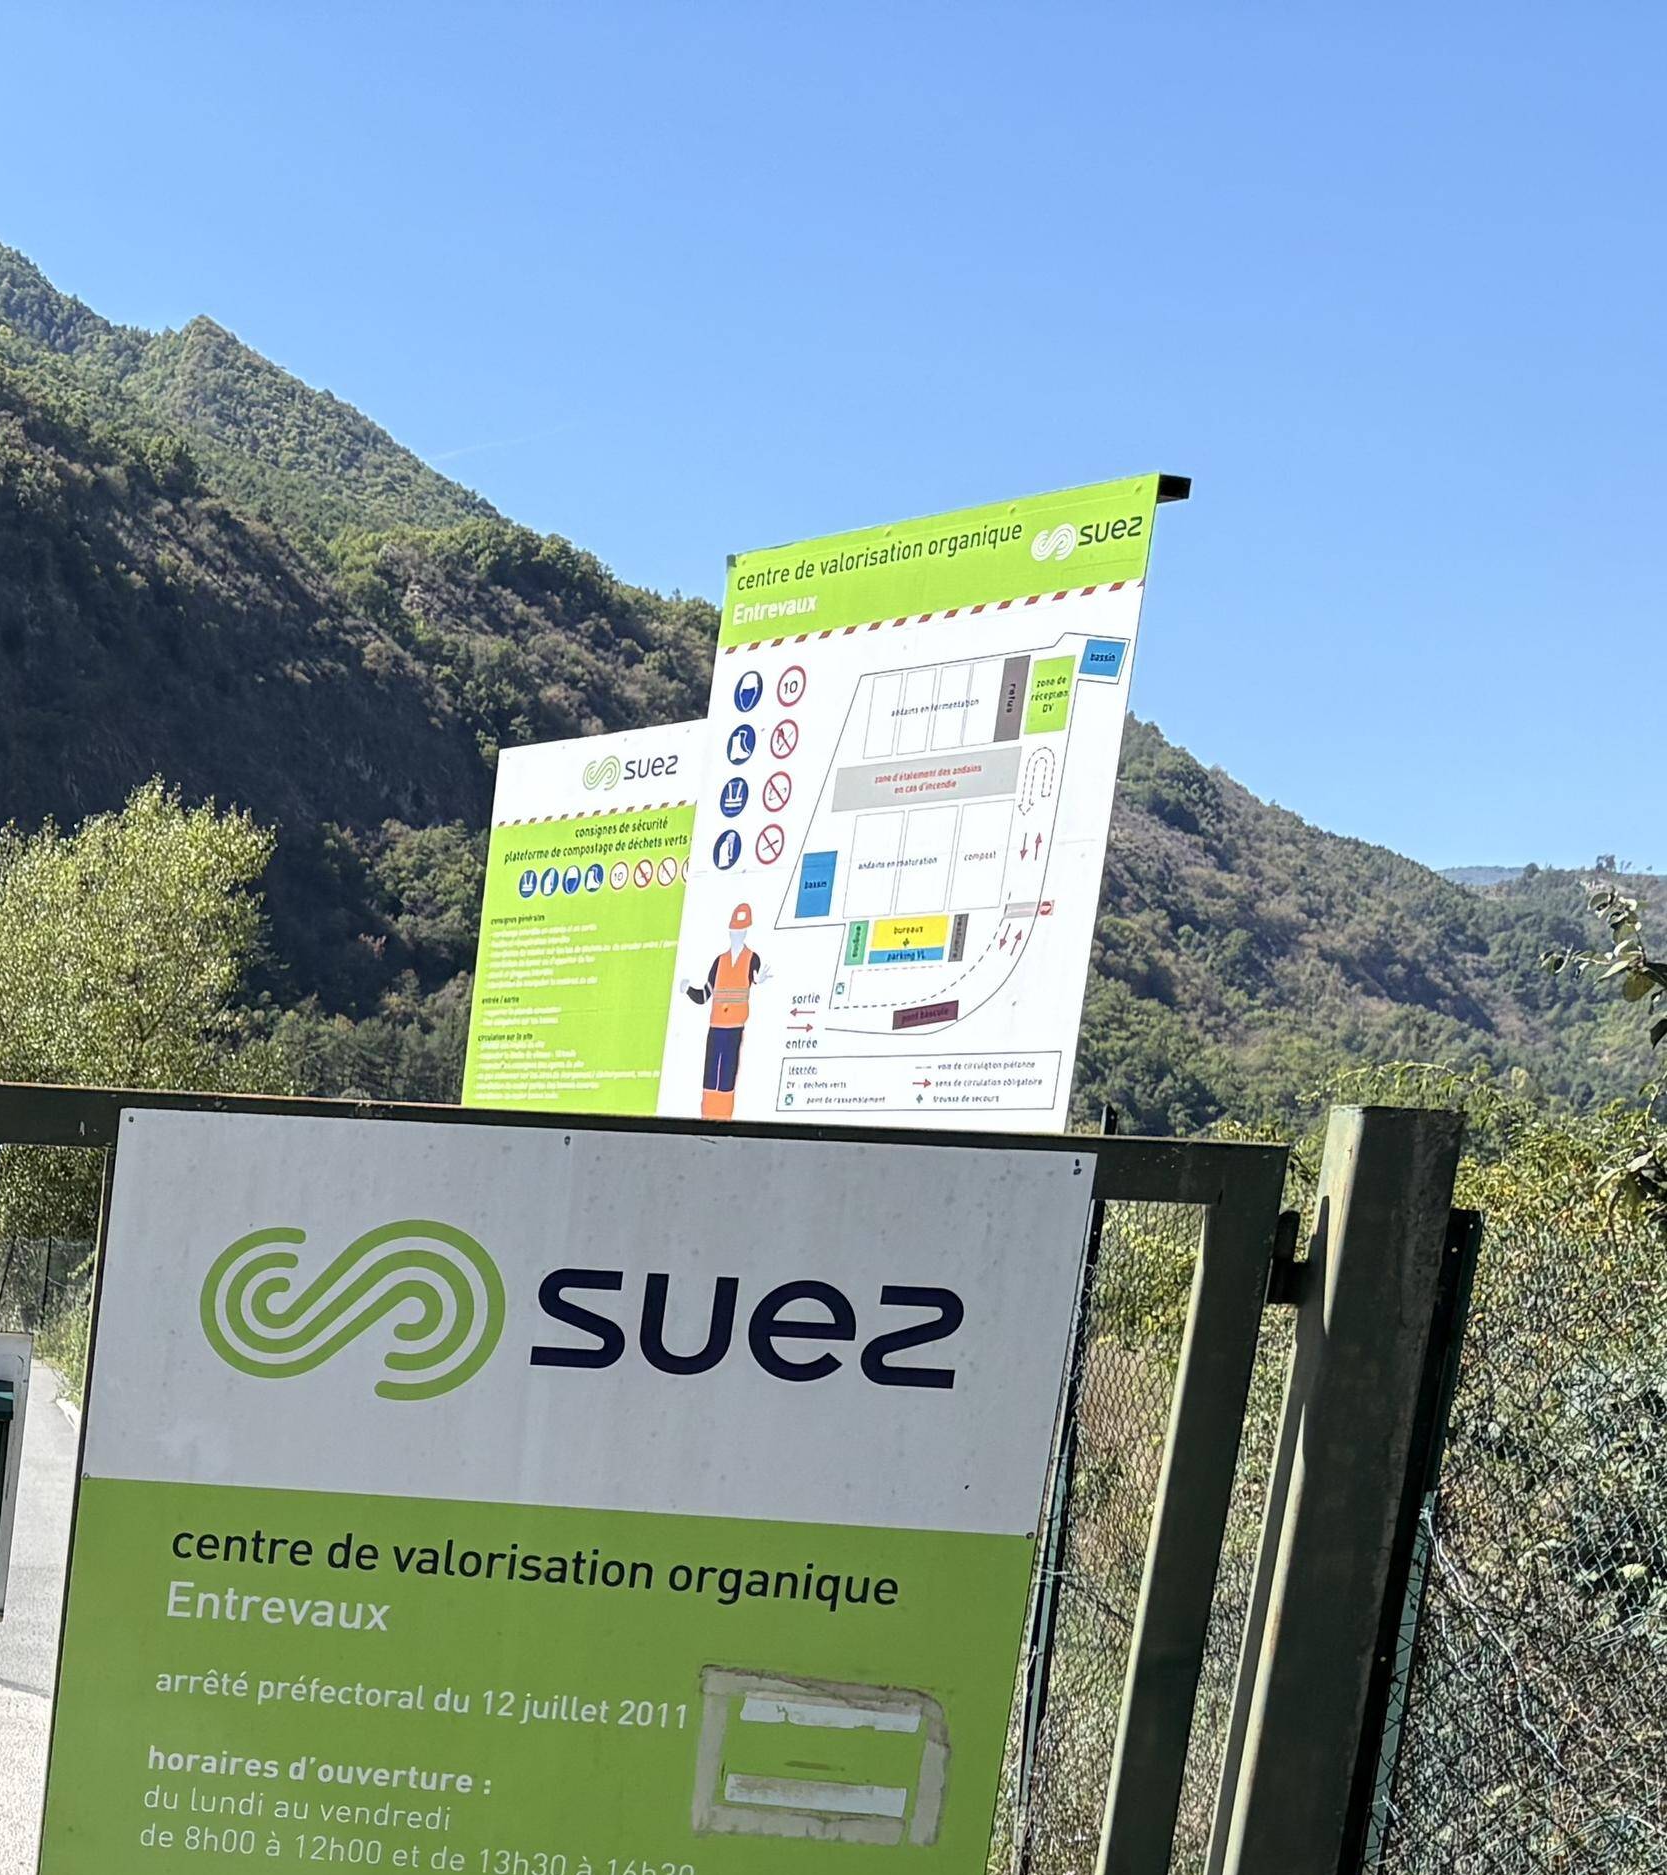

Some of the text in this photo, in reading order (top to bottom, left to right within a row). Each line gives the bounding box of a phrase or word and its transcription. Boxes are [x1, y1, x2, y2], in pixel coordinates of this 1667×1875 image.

[1078, 516, 1143, 546] suez
[737, 523, 1023, 591] centre de valorisation organique
[732, 595, 818, 626] Entrevaux
[784, 680, 799, 695] 10
[623, 755, 679, 780] suez
[575, 816, 669, 839] consignes de sécurité
[504, 833, 688, 865] plateforme de compostage de déchets verts
[614, 871, 624, 881] 10
[791, 993, 821, 1005] sortie
[785, 1038, 818, 1049] entrée
[529, 1267, 965, 1389] suez
[171, 1529, 899, 1612] centre de valorisation organique
[167, 1581, 391, 1632] Entrevaux
[155, 1669, 688, 1731] arrêté préfectoral du 12 juillet 2011
[147, 1745, 492, 1796] horaires d'ouverture :
[143, 1785, 451, 1832] du lundi au vendredi
[139, 1823, 174, 1848] de
[184, 1826, 256, 1855] 8h00
[265, 1829, 281, 1858] à
[295, 1834, 382, 1866] 12h00
[391, 1845, 420, 1869] et
[429, 1846, 466, 1872] de
